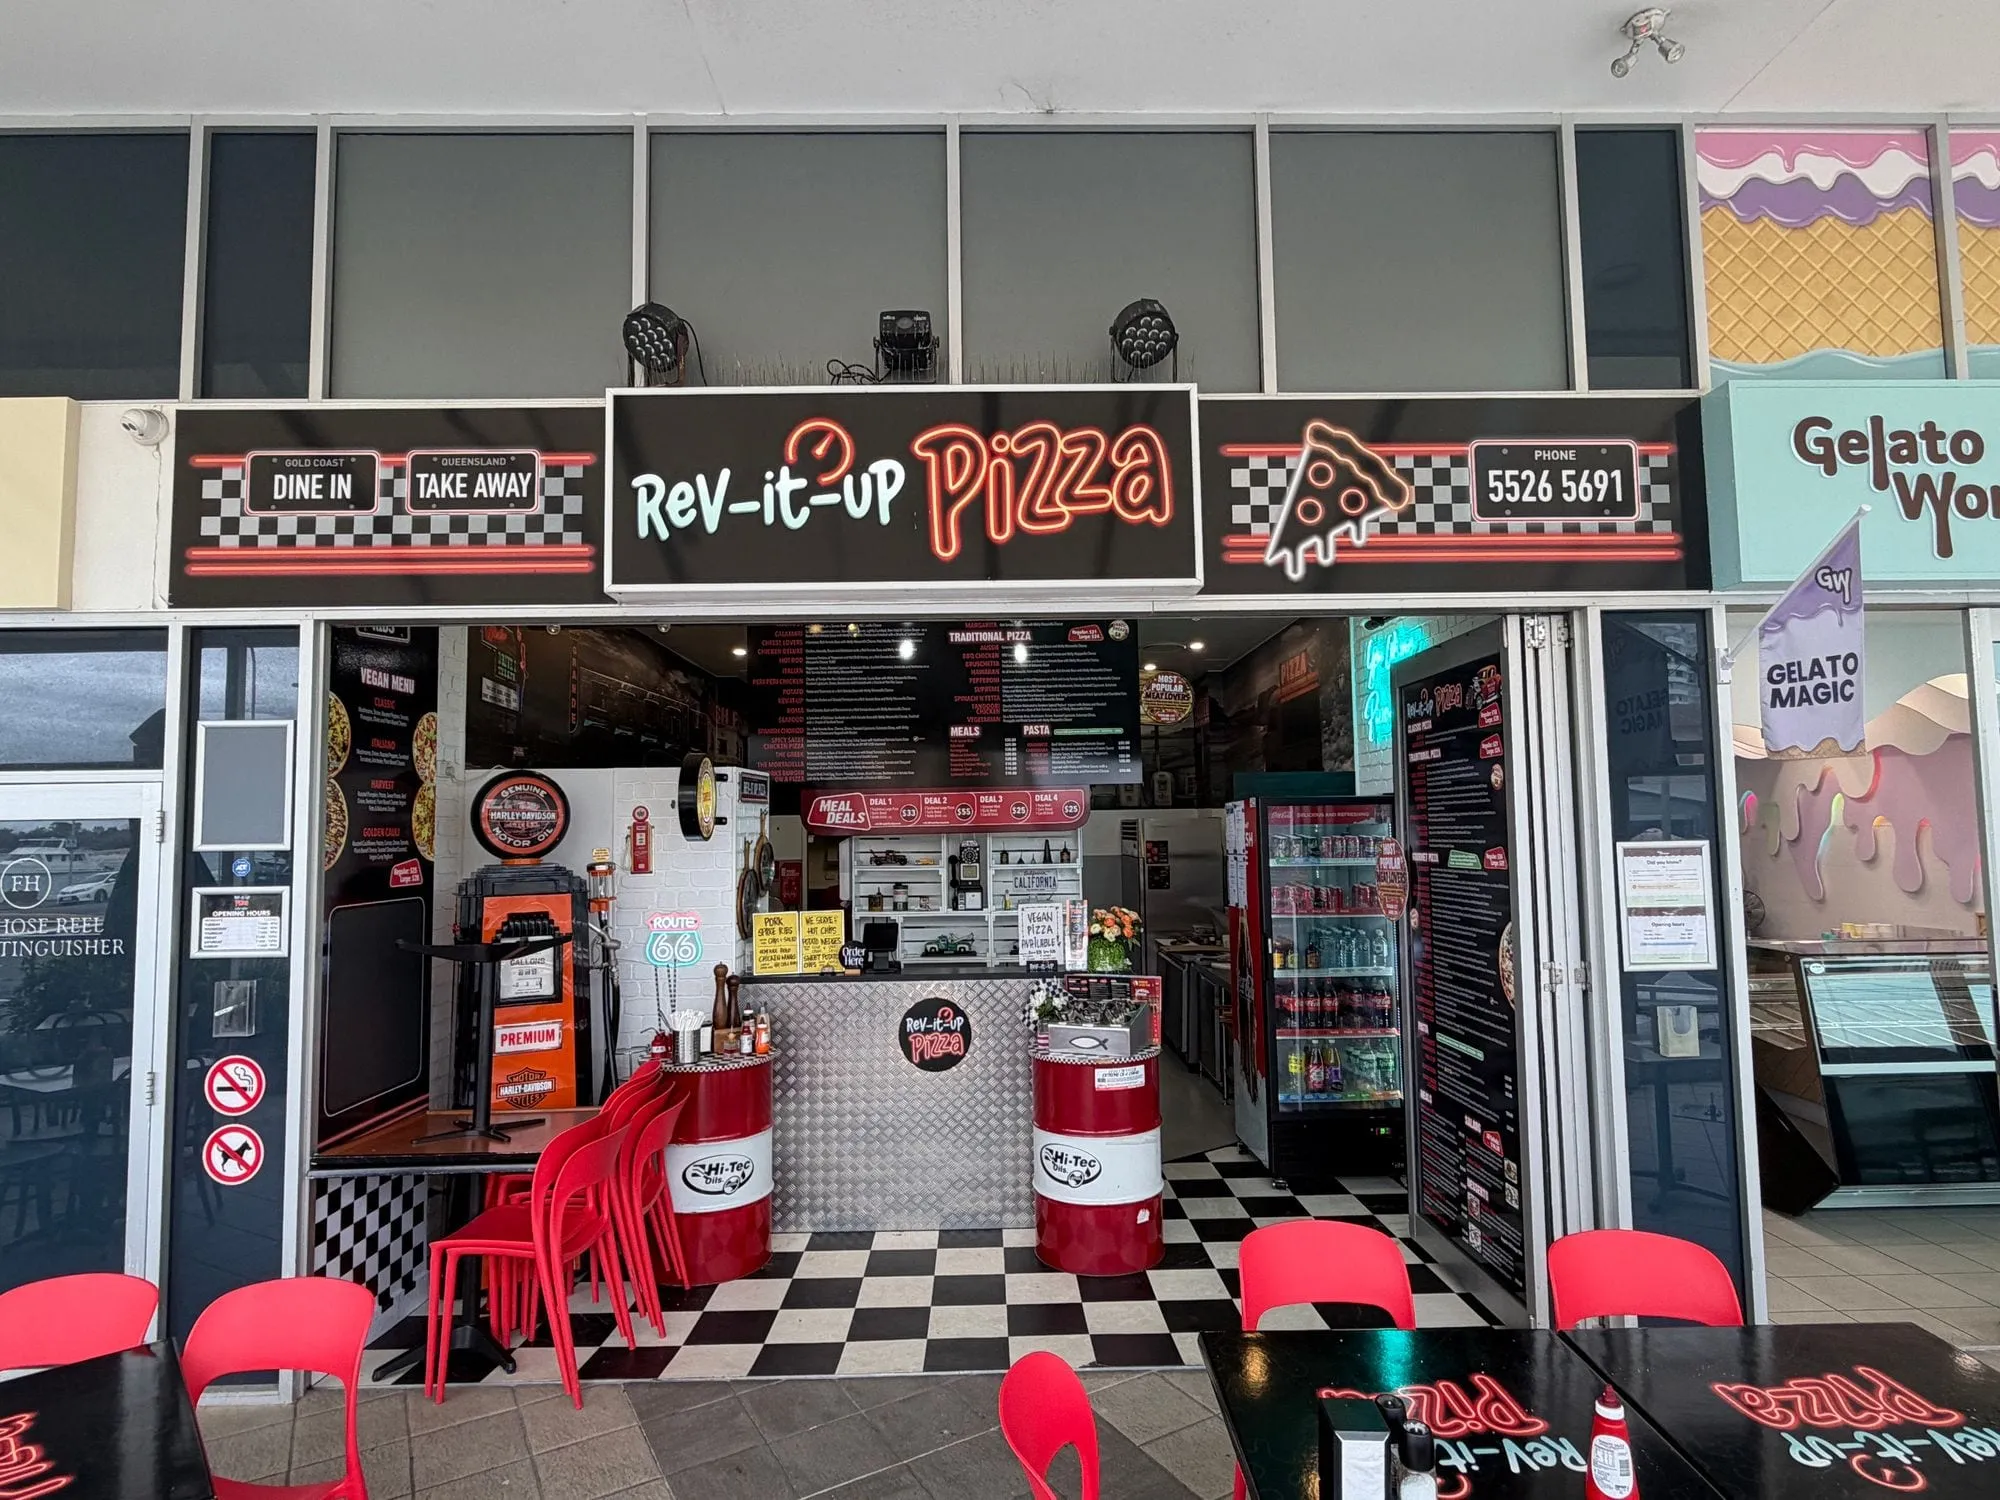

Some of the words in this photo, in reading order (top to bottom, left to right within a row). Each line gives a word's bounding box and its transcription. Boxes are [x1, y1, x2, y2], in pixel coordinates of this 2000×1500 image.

[1534, 450, 1577, 461] PHONE
[1790, 415, 1985, 492] Gelato
[285, 458, 310, 468] GOLD
[312, 458, 345, 468] COAST
[441, 457, 507, 466] QUEENSLAND
[273, 474, 323, 500] DINE
[330, 474, 352, 499] IN
[416, 473, 467, 499] TAKE
[473, 472, 532, 499] AWAY
[1488, 470, 1553, 503] 5526
[1561, 470, 1624, 503] 5691
[949, 632, 1004, 642] TRADITIONAL
[1007, 631, 1031, 641] PIZZA
[1767, 652, 1858, 684] GELATO
[360, 667, 389, 688] VEGAN
[391, 674, 415, 694] MENU
[1157, 675, 1177, 683] MOST
[1151, 683, 1183, 692] POPULAR
[1770, 679, 1854, 708] MAGIC
[950, 727, 980, 737] MEALS
[1023, 725, 1050, 735] PASTA
[501, 784, 547, 797] GENUINE
[819, 800, 853, 812] MEAL
[943, 796, 948, 804] 2
[901, 809, 916, 817] $33
[956, 808, 971, 816] $55
[1012, 806, 1026, 814] $25
[1064, 805, 1078, 813] $25
[826, 812, 865, 824] DEALS
[493, 826, 531, 847] MOTOR
[537, 828, 554, 841] OIL
[12, 875, 40, 892] FH
[1014, 876, 1057, 888] CALIFORNIA
[653, 917, 695, 928] ROUTE
[764, 917, 784, 926] PORK
[1027, 912, 1053, 923] VEGAN
[56, 917, 104, 934] REEL
[1027, 924, 1053, 935] PIZZA
[652, 933, 697, 961] 66
[842, 946, 865, 957] Order
[843, 956, 864, 966] Here
[501, 1029, 555, 1046] PREMIUM
[508, 1073, 544, 1082] MOTOR
[500, 1082, 552, 1096] HARLEY-DAVIDSON
[507, 1094, 544, 1105] CYCLES
[1054, 1151, 1097, 1168] Hi-Tec
[707, 1161, 750, 1176] Hi-Tec
